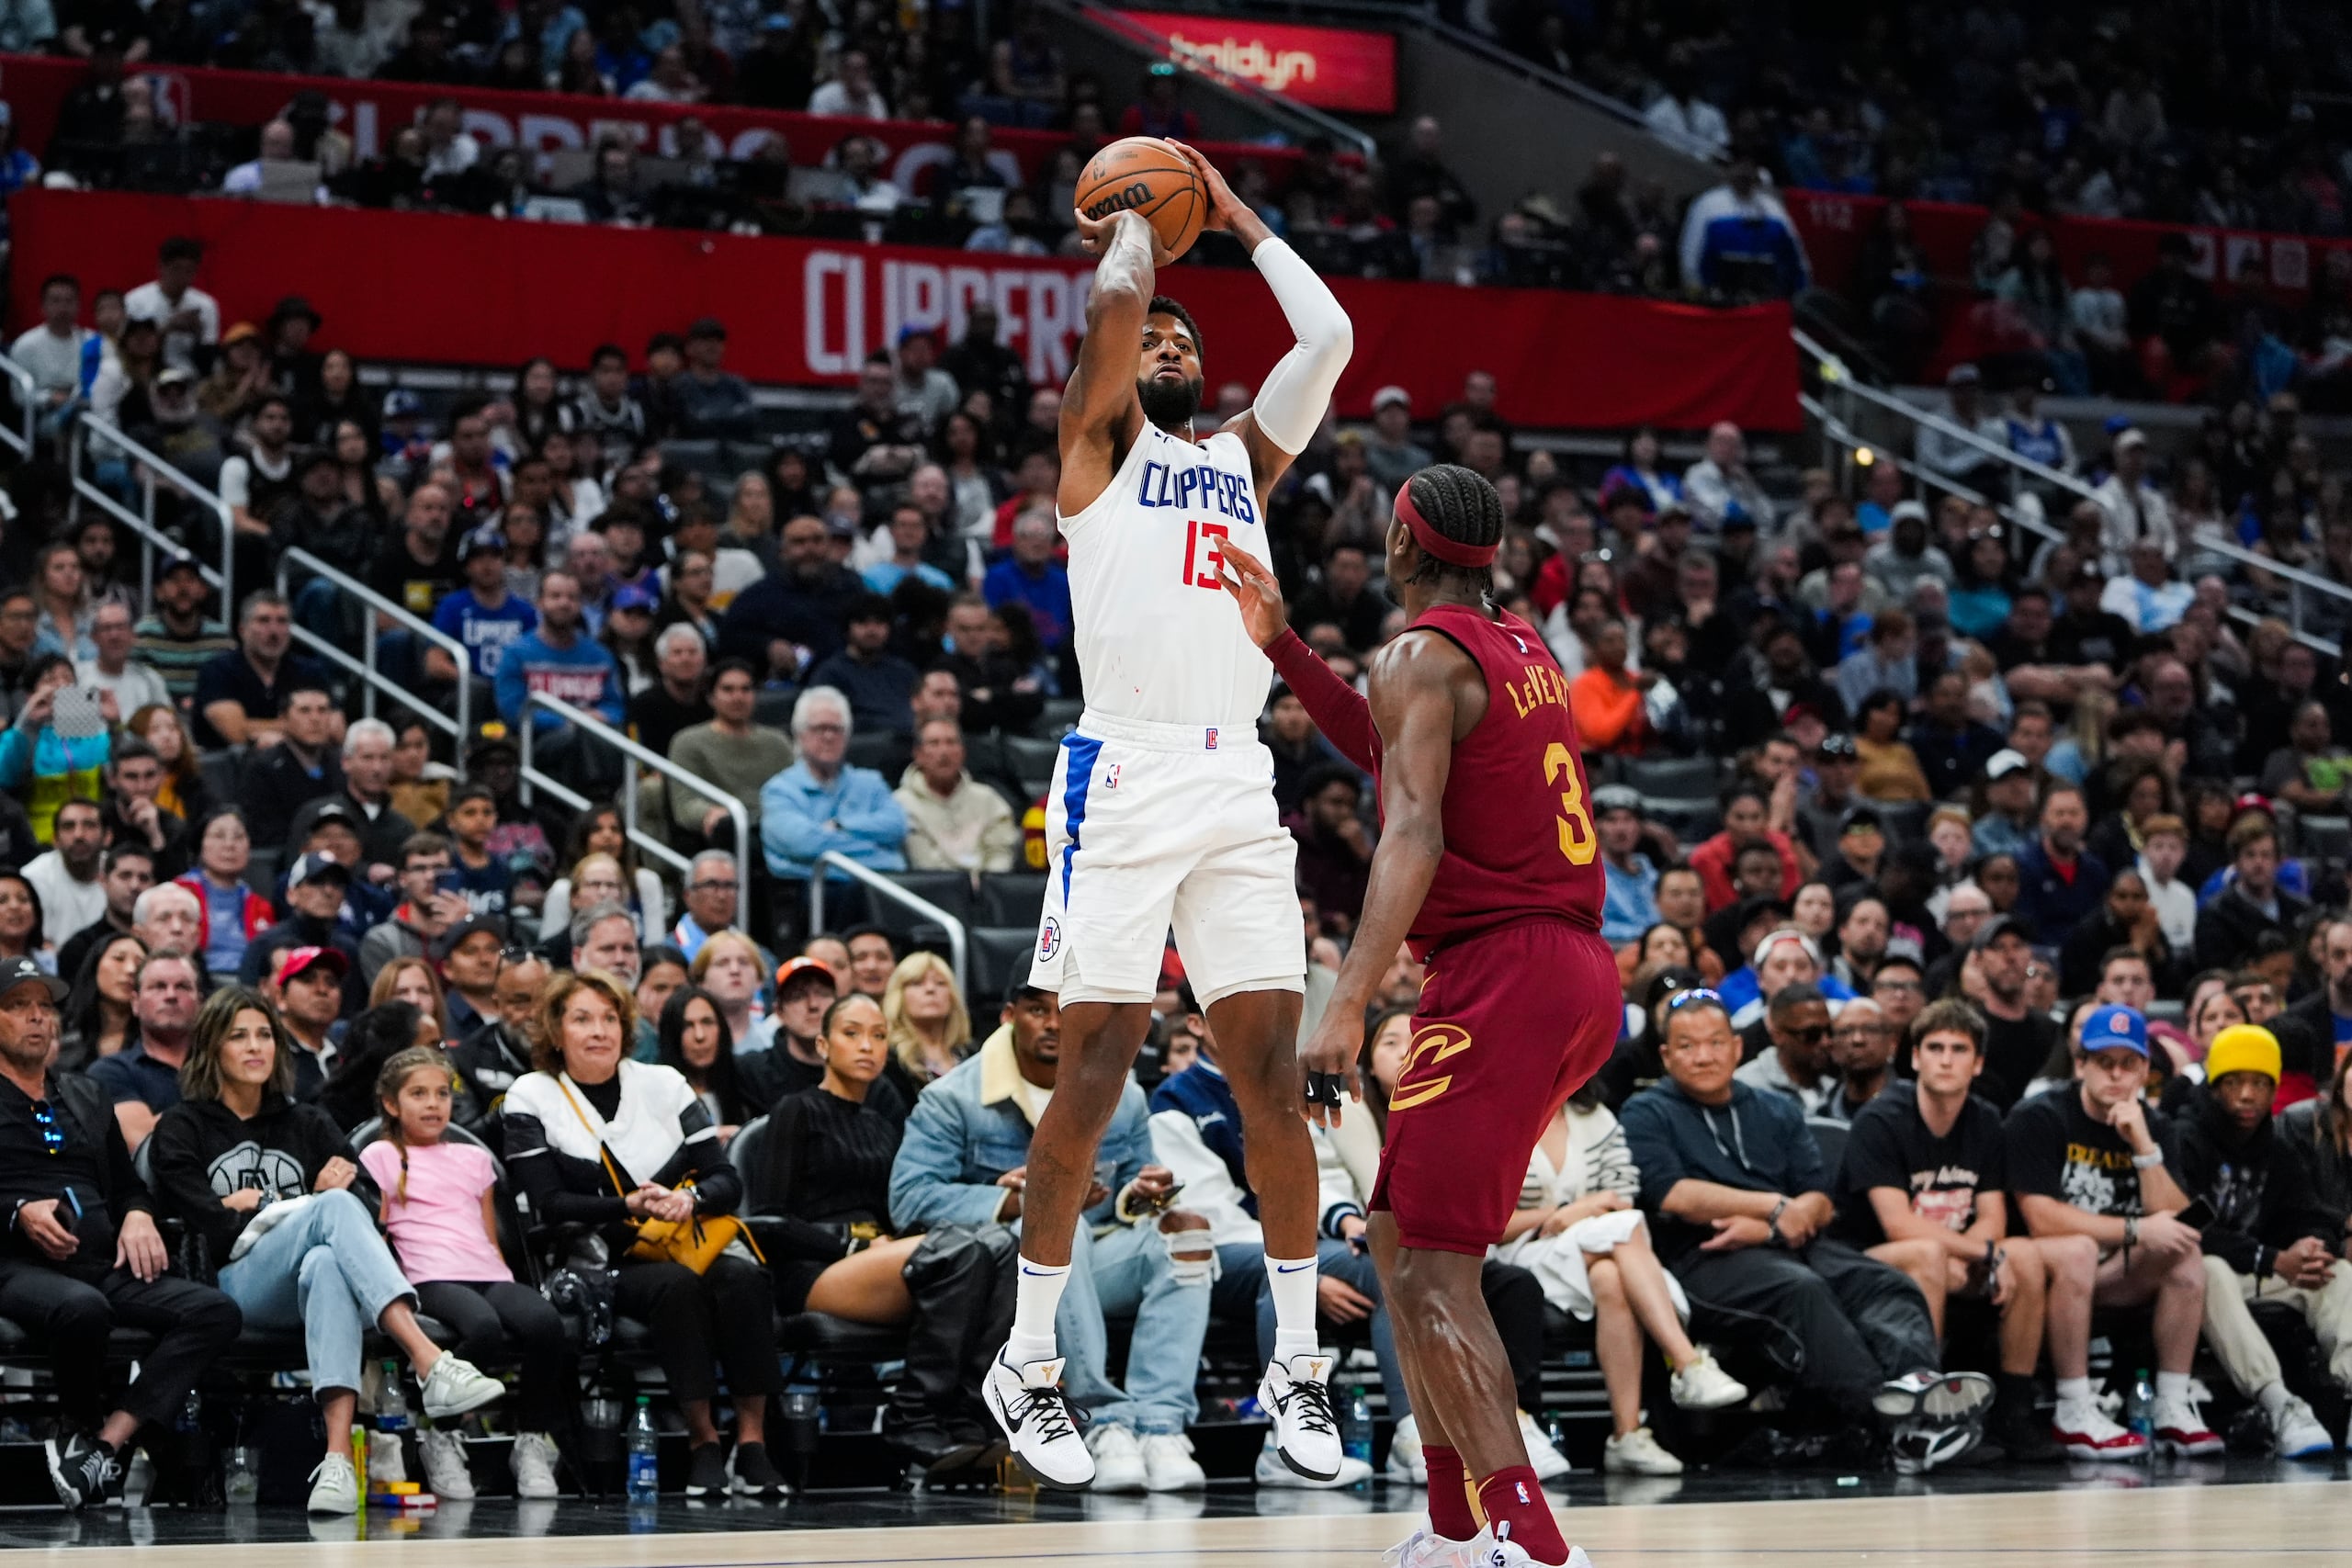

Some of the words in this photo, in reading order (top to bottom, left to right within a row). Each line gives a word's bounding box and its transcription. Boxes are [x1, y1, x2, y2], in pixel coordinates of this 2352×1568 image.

[1138, 460, 1255, 525] CLIPPERS
[1182, 520, 1228, 591] 13
[1544, 742, 1597, 865] 3
